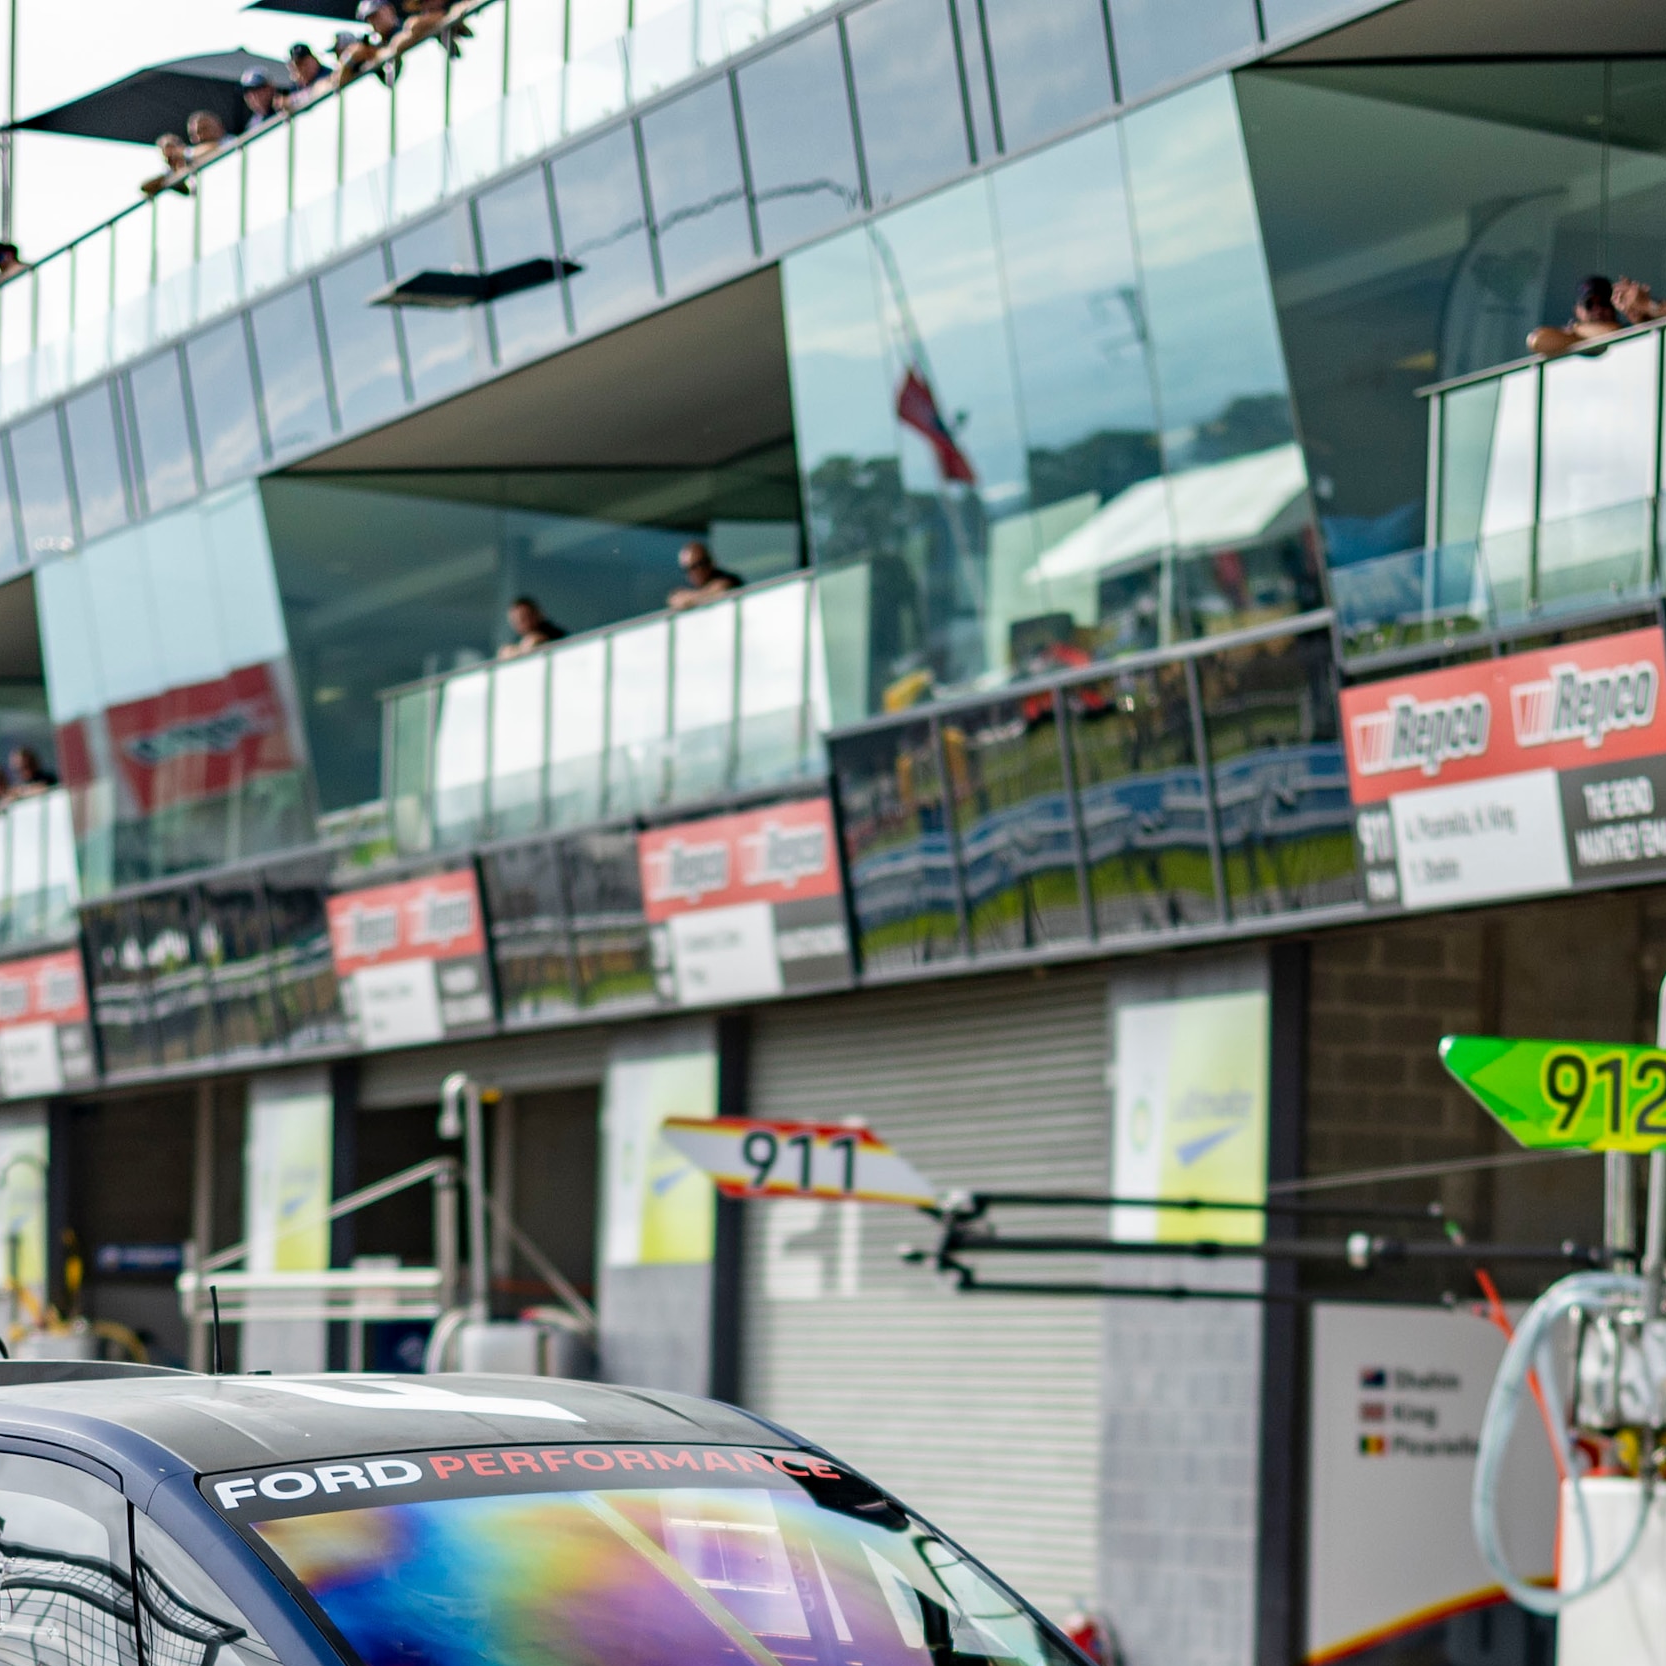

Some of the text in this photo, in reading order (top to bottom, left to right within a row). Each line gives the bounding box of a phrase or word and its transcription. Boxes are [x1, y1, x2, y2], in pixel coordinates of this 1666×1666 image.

[1390, 666, 1654, 771] Repco Repco
[742, 1131, 856, 1191] 911
[214, 1449, 843, 1510] FORD PERFORMANCE
